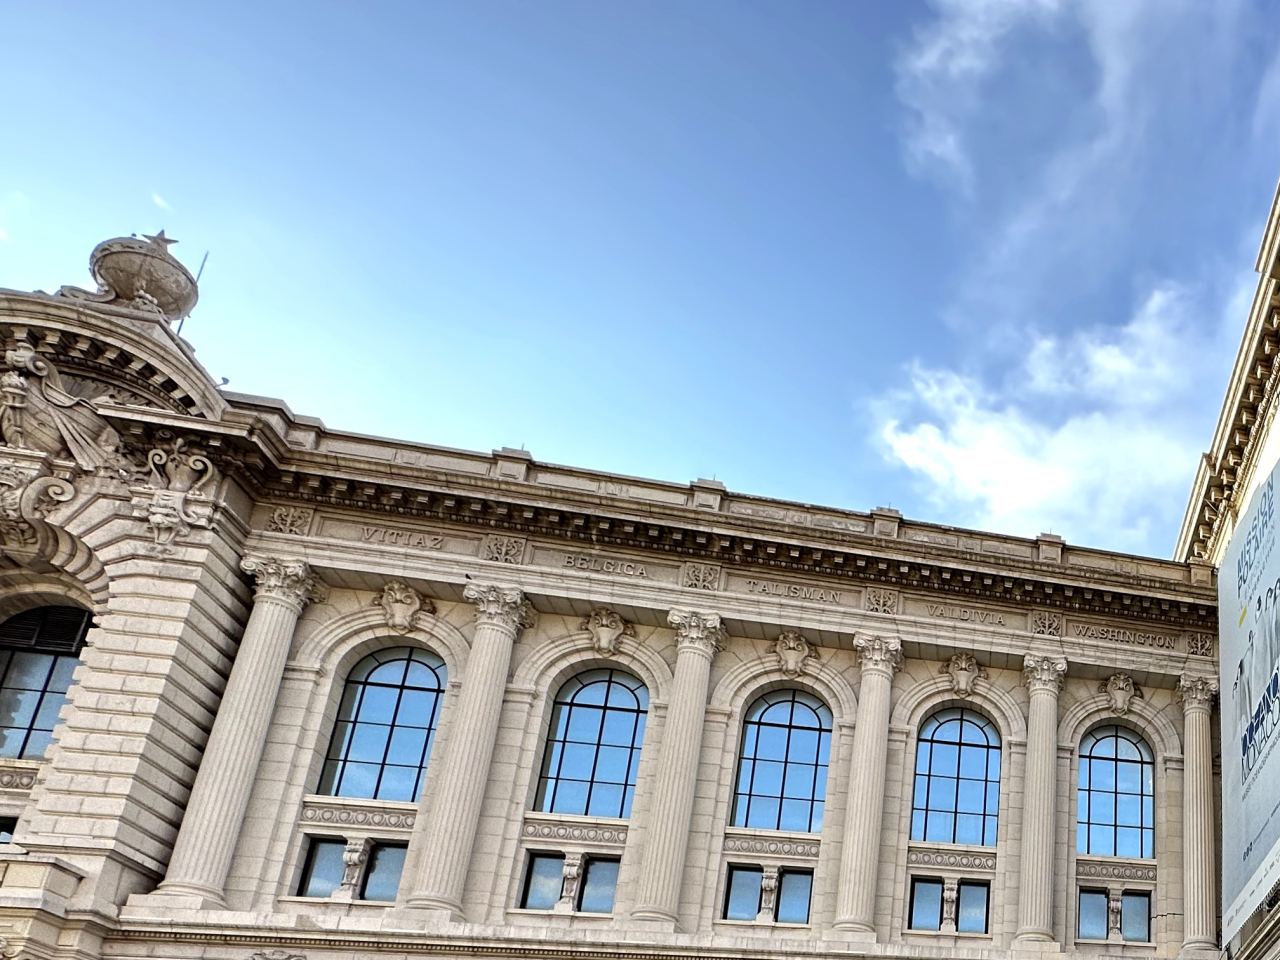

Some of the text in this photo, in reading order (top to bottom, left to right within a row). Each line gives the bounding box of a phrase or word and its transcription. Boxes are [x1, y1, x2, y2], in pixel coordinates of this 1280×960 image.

[1237, 470, 1274, 577] MISSION
[361, 526, 444, 549] VITIAZ
[1237, 493, 1275, 598] POLAIRE
[562, 553, 648, 578] BELGICA
[746, 580, 841, 604] TALISMAN
[925, 604, 1006, 627] VALDIVIA
[1073, 624, 1176, 649] WASHINGTON
[1241, 696, 1280, 786] MONACO
